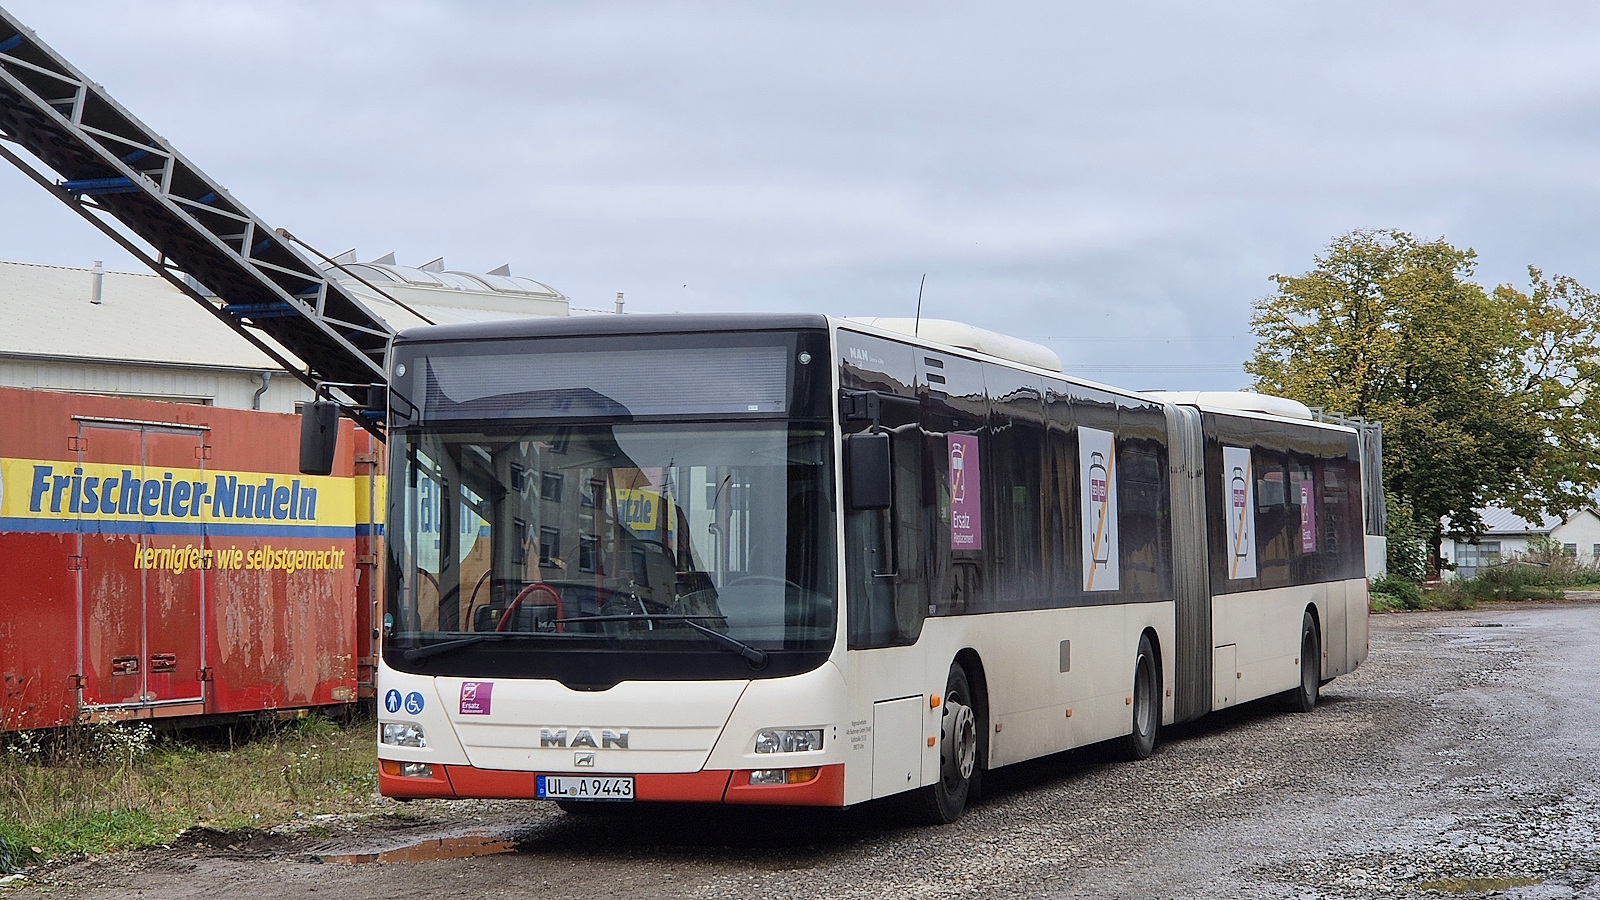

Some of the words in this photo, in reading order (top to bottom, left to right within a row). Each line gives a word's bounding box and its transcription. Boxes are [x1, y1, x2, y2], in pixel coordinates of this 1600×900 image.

[849, 346, 868, 361] MAN
[30, 465, 318, 521] Frischeier-Nudeln
[606, 490, 652, 524] ätzle
[953, 510, 970, 529] Ersatz
[134, 542, 213, 575] kernigfein
[217, 544, 243, 570] wie
[245, 544, 345, 574] selbstgemacht
[540, 728, 629, 749] MAN
[547, 778, 568, 795] UL
[579, 779, 588, 796] A
[592, 779, 631, 796] 9443
